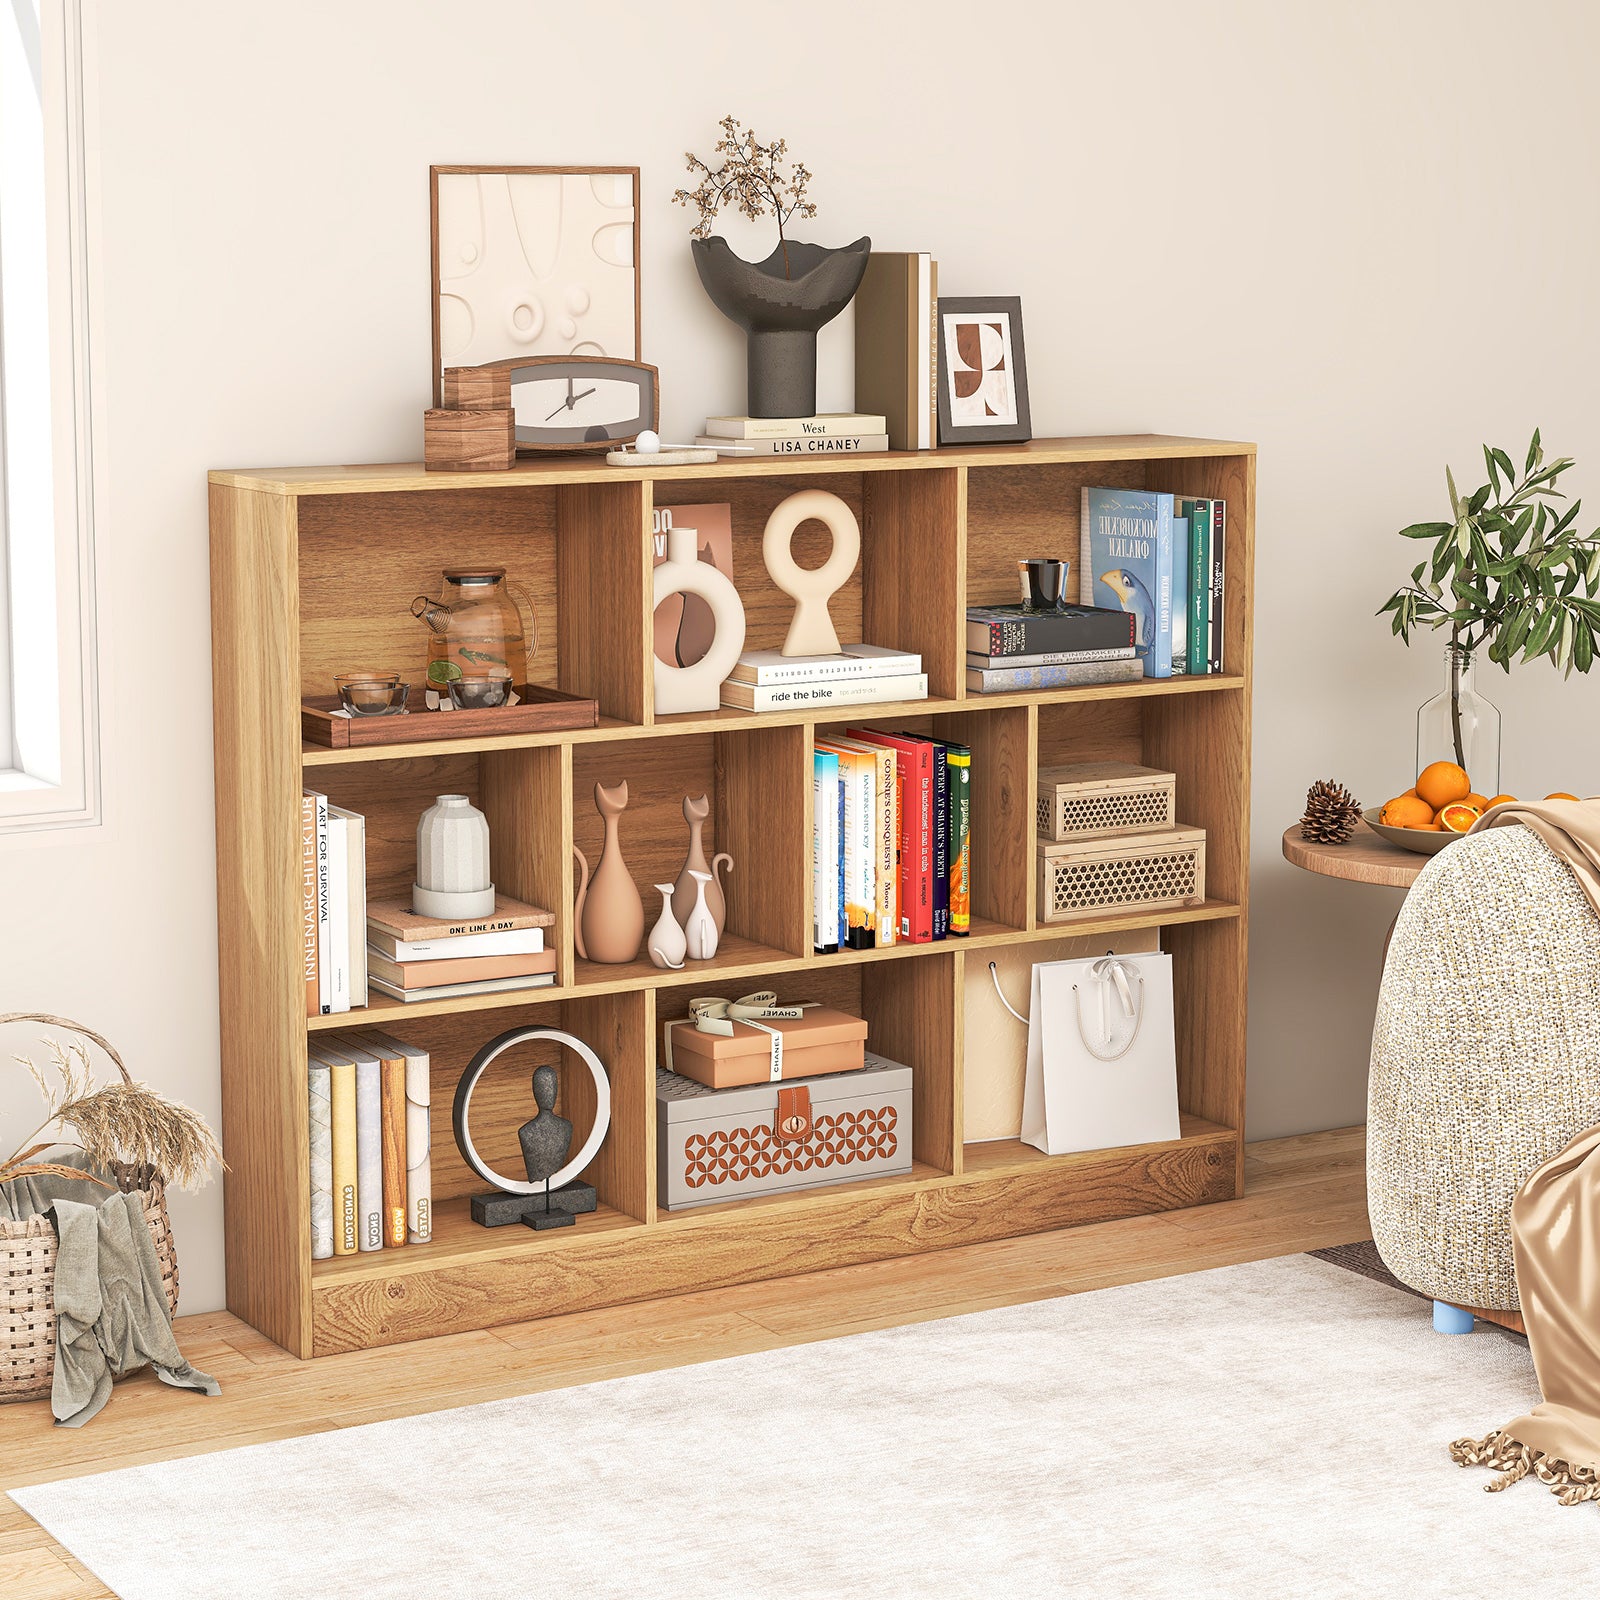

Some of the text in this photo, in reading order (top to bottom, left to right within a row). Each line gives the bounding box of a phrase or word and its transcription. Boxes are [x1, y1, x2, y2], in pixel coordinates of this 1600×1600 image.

[802, 423, 826, 434] West
[773, 439, 860, 453] LISA CHANEY
[1062, 650, 1121, 658] EINSAMKEIT
[774, 666, 863, 678] SELECTED STORIES
[771, 692, 791, 702] ride
[793, 690, 809, 700] the
[812, 689, 833, 699] bike
[938, 796, 945, 807] AT
[937, 809, 945, 848] SHARK'S
[883, 809, 891, 871] CONQUESTS
[961, 799, 969, 894] Fantasy World
[318, 805, 328, 924] ART FOR SURVIVAL
[937, 850, 945, 878] TEETH
[303, 797, 316, 981] INNENARCHITEKTUR
[450, 927, 465, 935] ONE
[469, 924, 487, 933] LINE
[498, 922, 513, 930] DAY
